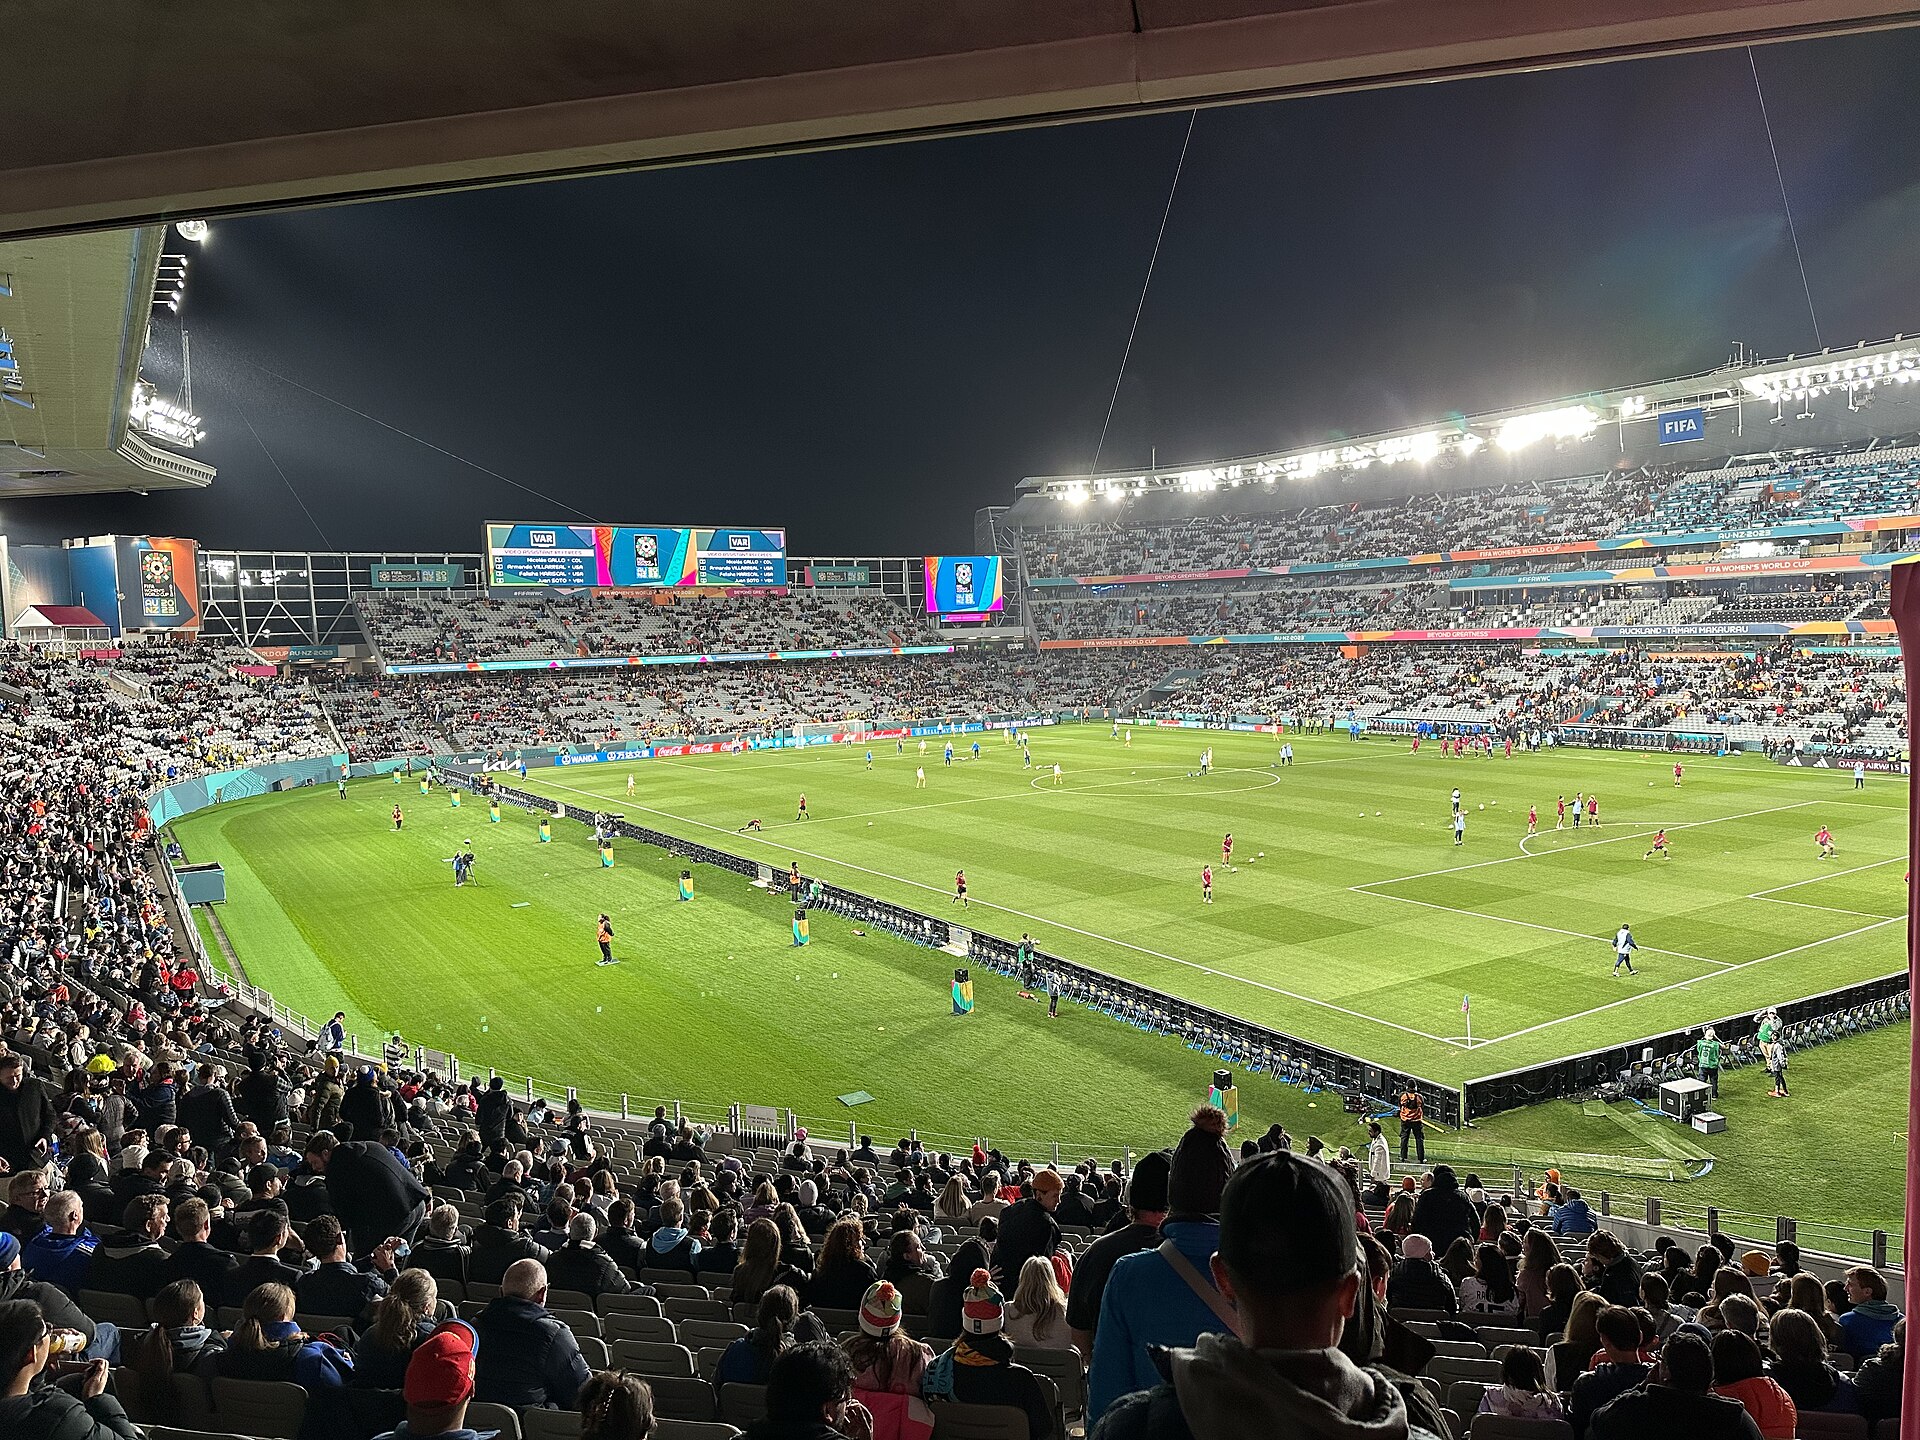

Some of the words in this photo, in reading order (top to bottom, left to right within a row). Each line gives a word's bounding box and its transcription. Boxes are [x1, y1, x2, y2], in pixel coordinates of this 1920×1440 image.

[1665, 418, 1697, 434] FIFA
[533, 534, 553, 543] VAR
[1522, 547, 1545, 555] WORLD
[1721, 564, 1760, 572] WOMEN'S
[1761, 562, 1791, 570] WORLD
[1619, 627, 1662, 635] AUCKLAND
[1699, 626, 1749, 634] MAKAURAU
[865, 732, 902, 740] Budweiser
[570, 754, 598, 763] WANDA
[483, 760, 520, 772] KIA
[1866, 762, 1899, 770] AIRWAS
